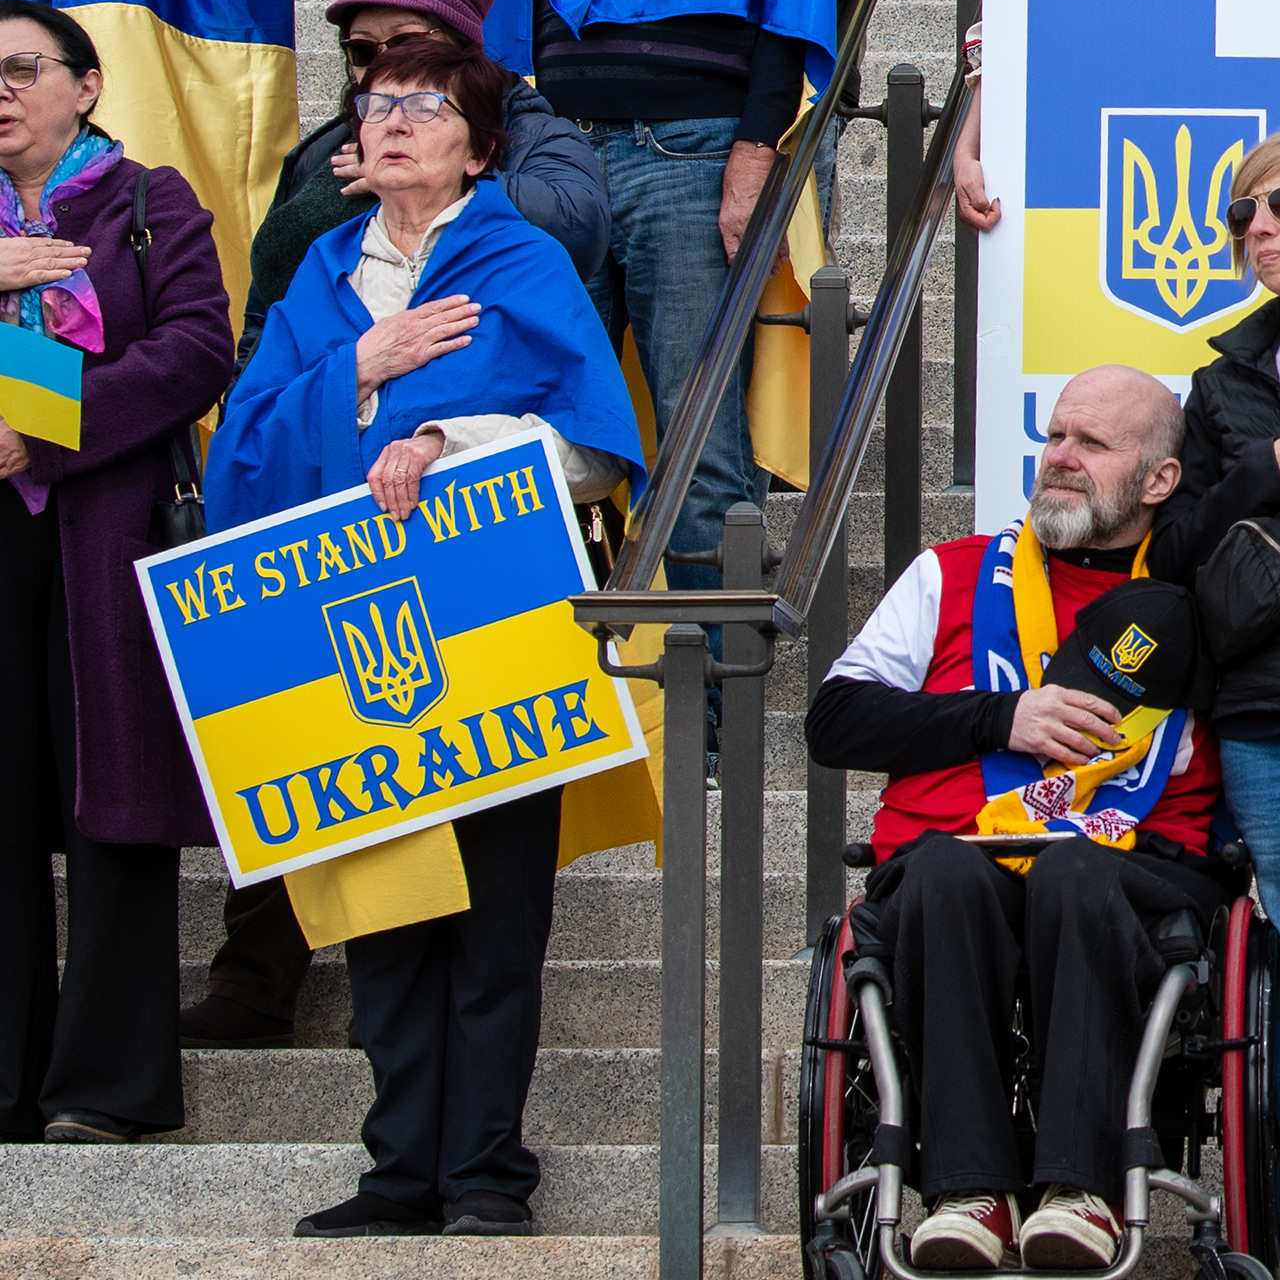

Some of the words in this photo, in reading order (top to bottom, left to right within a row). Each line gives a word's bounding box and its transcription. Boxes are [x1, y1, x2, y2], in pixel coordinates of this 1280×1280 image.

[165, 560, 247, 626] WE
[254, 512, 407, 599] STAND
[418, 464, 546, 544] WITH
[1088, 645, 1146, 697] UKRAINE
[236, 678, 610, 846] UKRAINE
